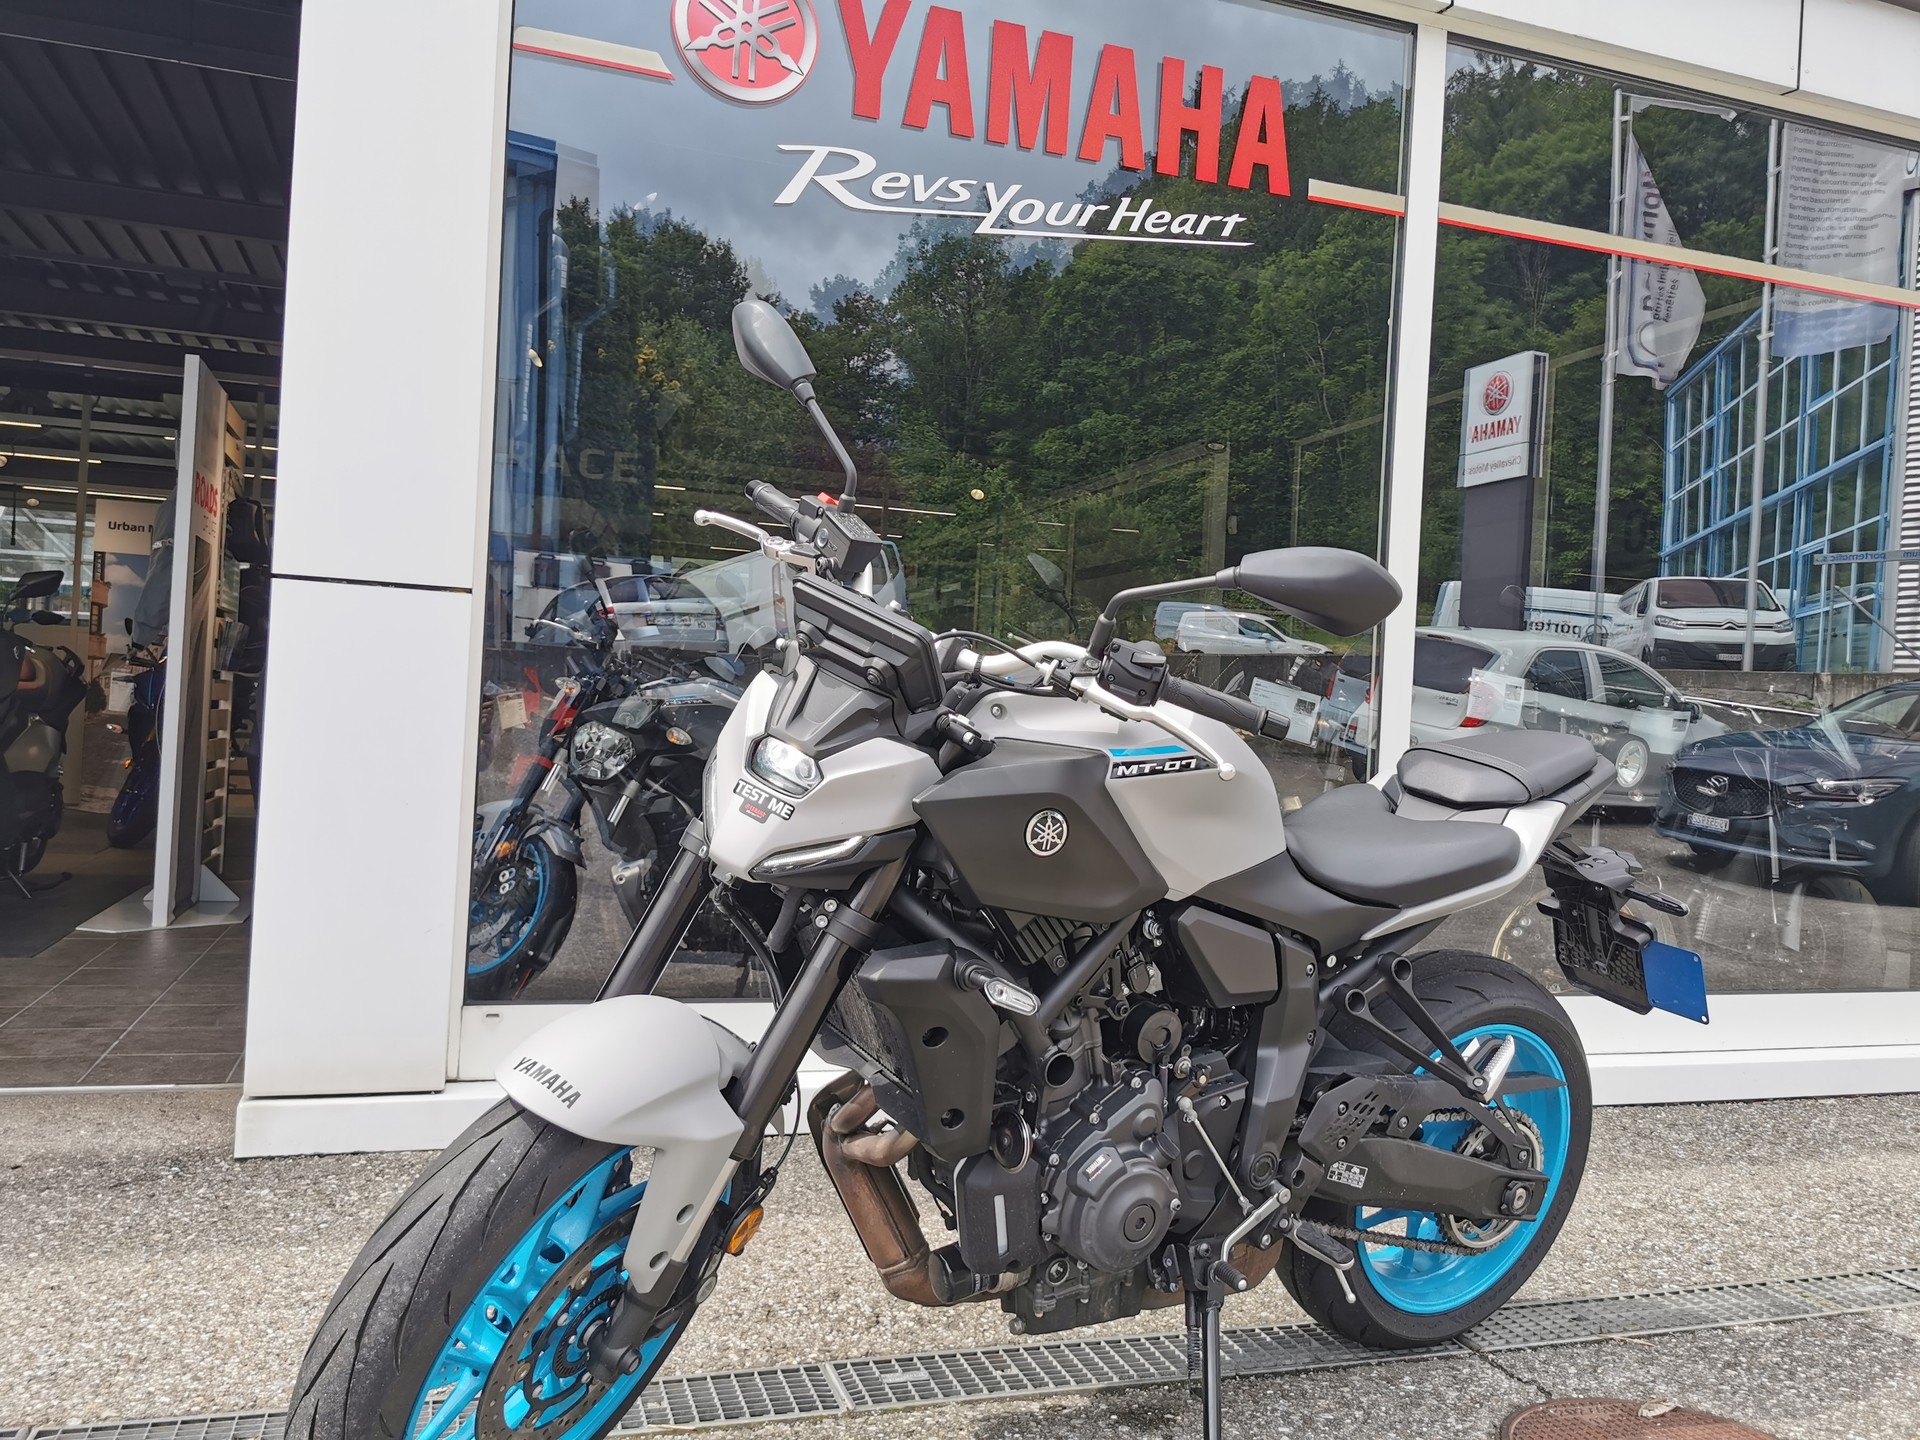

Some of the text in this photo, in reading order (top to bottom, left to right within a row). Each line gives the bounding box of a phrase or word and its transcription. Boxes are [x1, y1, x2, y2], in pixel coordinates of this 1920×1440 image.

[838, 0, 1291, 197] YAMAHA
[773, 144, 1248, 238] Revs Your Heart
[108, 520, 145, 533] Urban
[1116, 758, 1197, 776] MT-07
[735, 779, 770, 805] TEST
[767, 796, 794, 819] ME
[512, 1056, 582, 1110] YAMAHA
